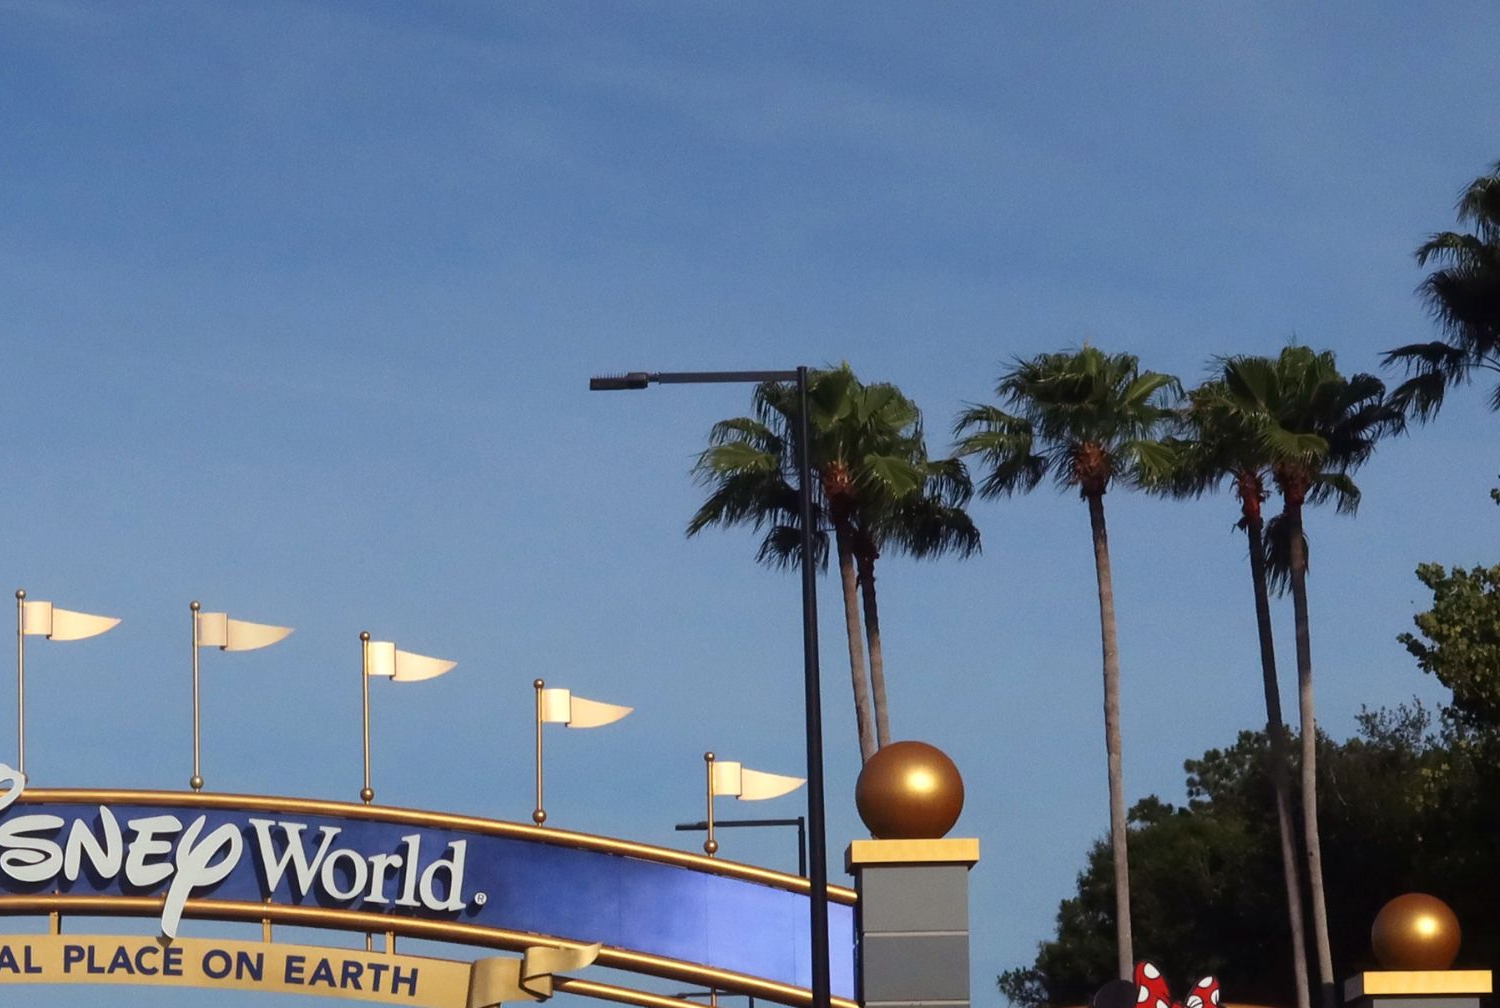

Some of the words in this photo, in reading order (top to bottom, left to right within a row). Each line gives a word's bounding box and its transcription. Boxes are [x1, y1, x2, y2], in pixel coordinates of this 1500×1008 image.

[63, 945, 184, 976] PLACE
[202, 949, 264, 981] ON
[284, 955, 419, 997] EARTH
